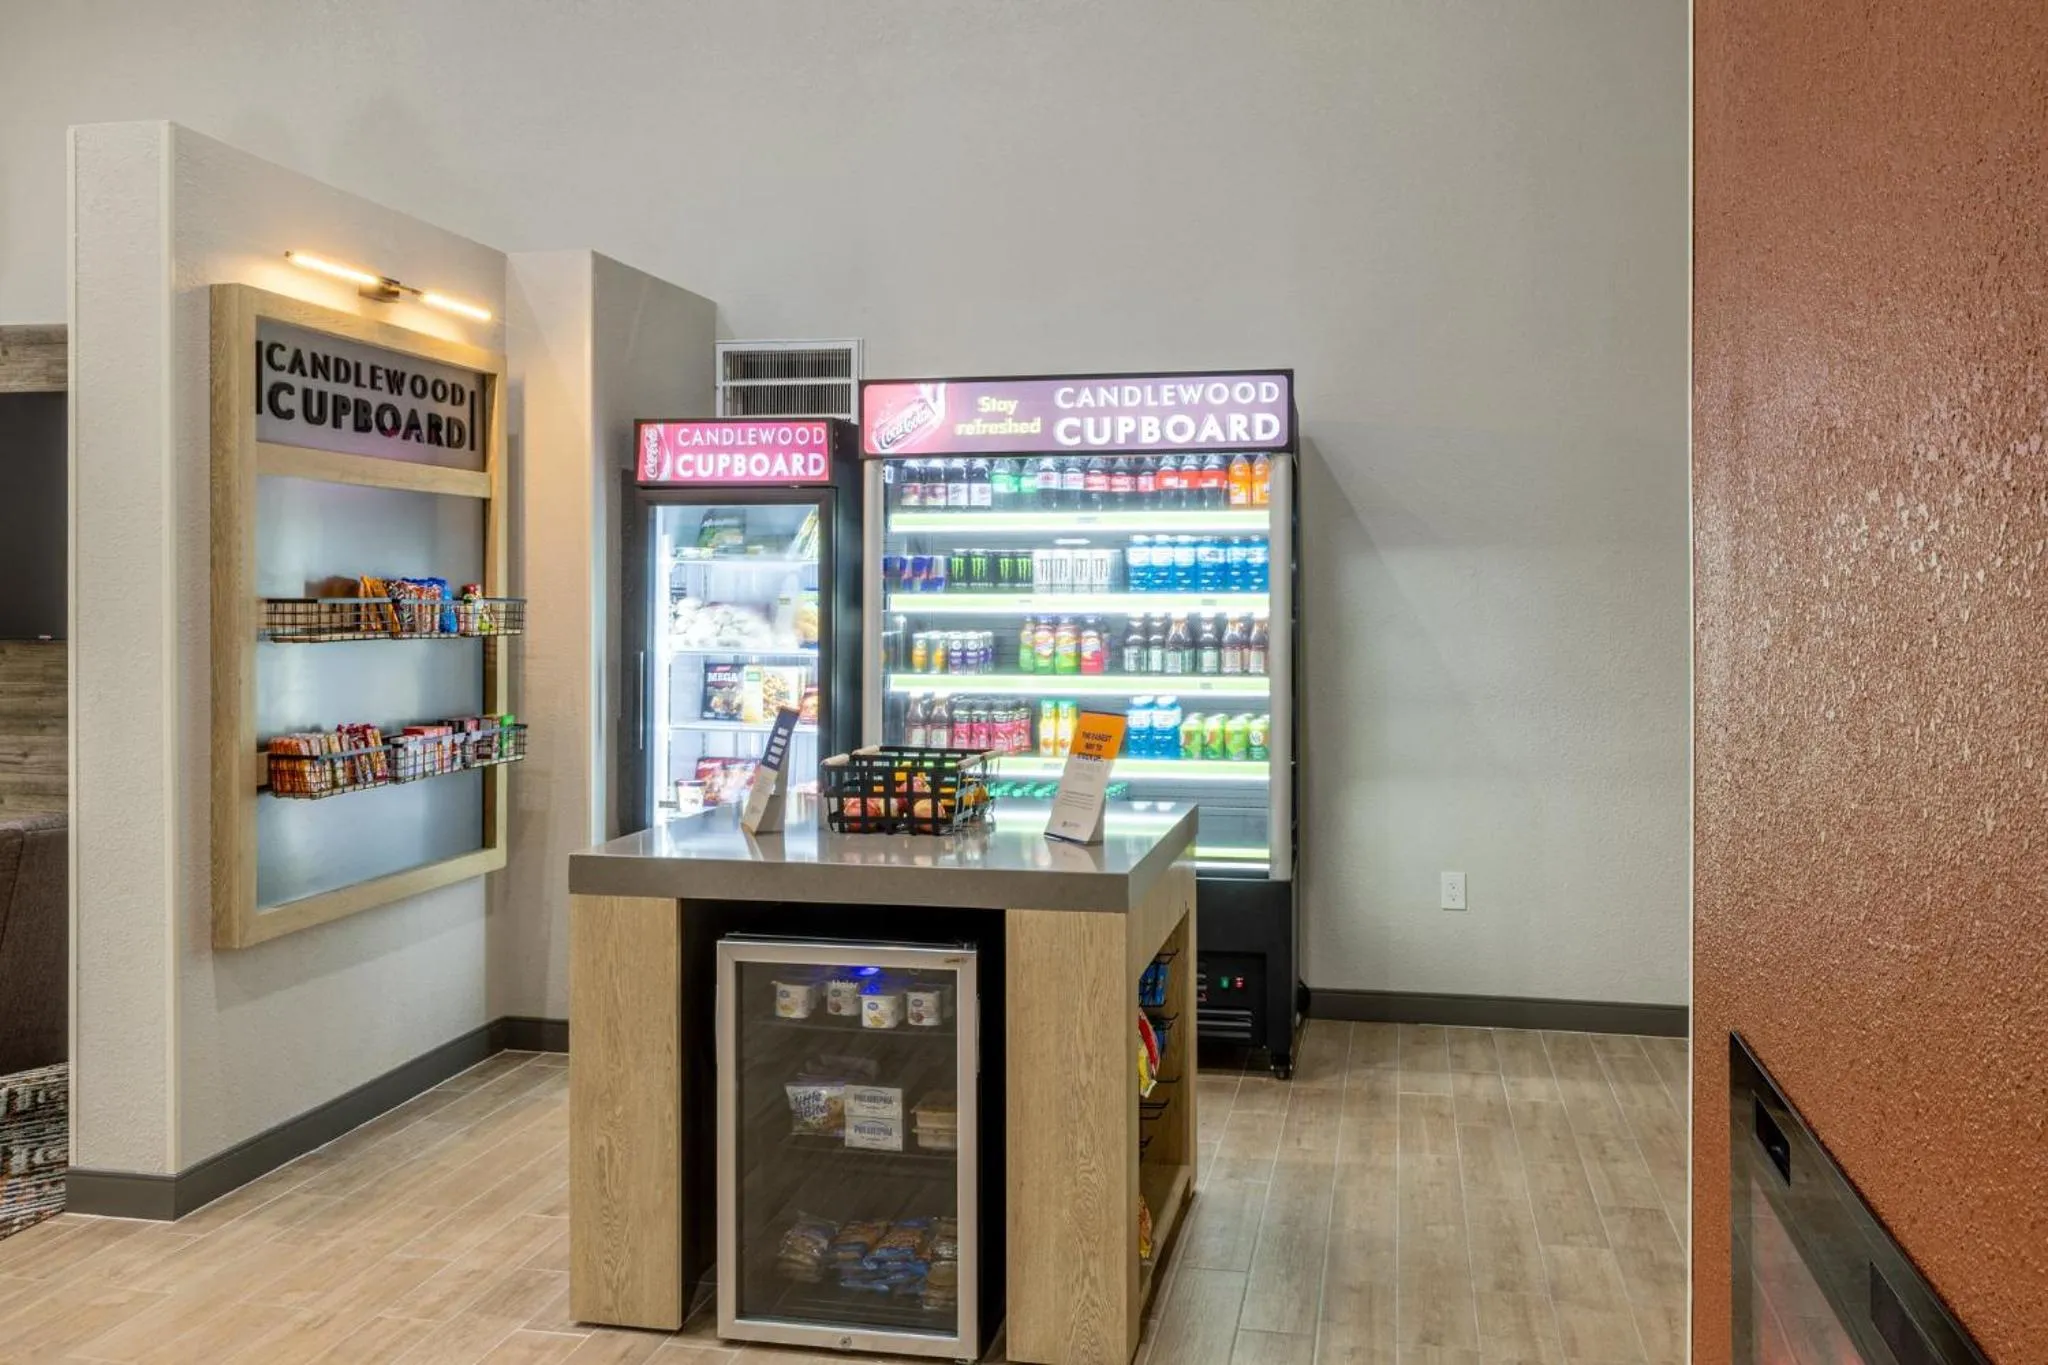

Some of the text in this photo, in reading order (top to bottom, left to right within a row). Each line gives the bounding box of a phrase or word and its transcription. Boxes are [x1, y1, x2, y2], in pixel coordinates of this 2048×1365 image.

[265, 342, 466, 408] CANDLEWOOD
[978, 396, 1019, 416] Stay
[1053, 381, 1280, 409] CANDLEWOOD
[267, 381, 467, 450] CUPBOARD
[955, 416, 1042, 436] refreshed
[1053, 412, 1281, 446] CUPBOARD
[677, 426, 826, 447] CANDLEWOOD
[675, 452, 826, 478] CUPBOARD
